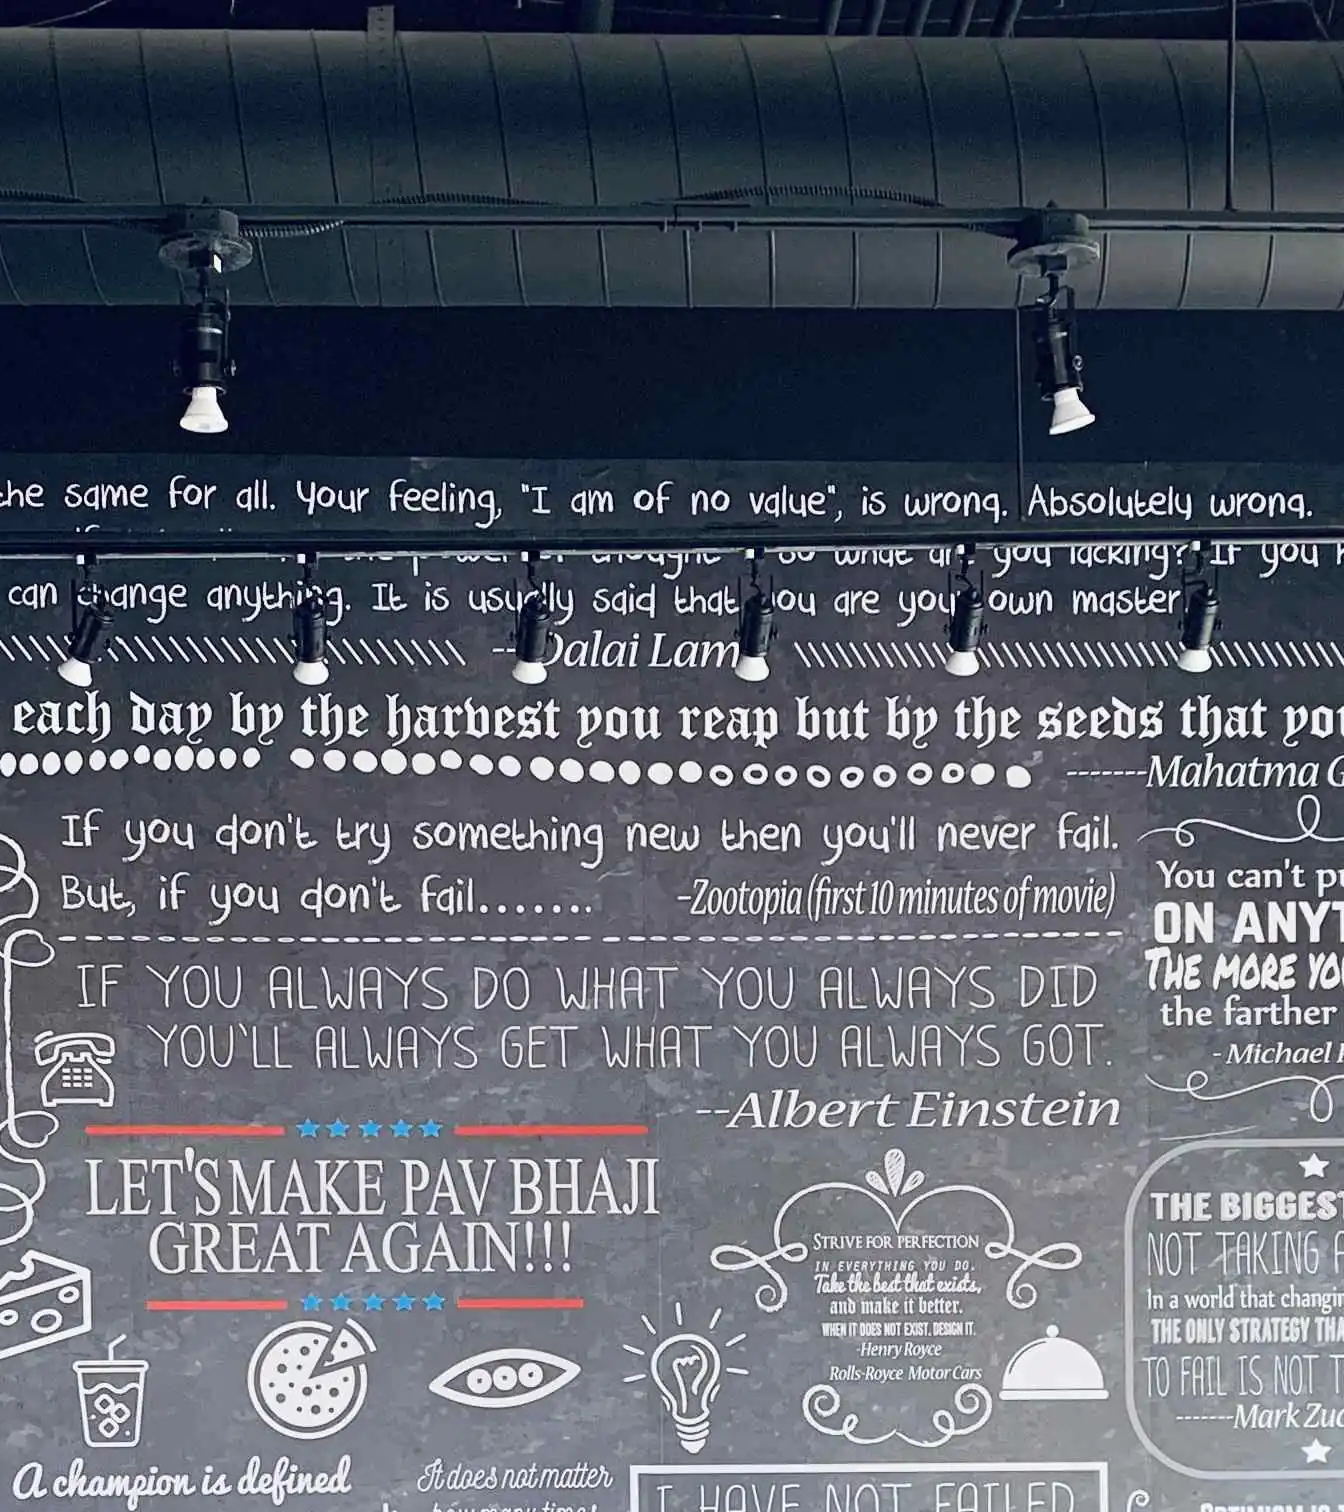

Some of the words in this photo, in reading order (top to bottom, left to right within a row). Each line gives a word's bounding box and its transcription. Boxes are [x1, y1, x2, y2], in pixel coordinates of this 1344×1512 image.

[64, 483, 149, 511] same
[168, 474, 217, 509] for
[236, 479, 276, 513] all.
[389, 476, 503, 527] feeling,
[570, 489, 614, 517] am
[633, 480, 674, 514] of
[691, 489, 730, 516] no
[861, 485, 887, 516] is
[1027, 483, 1192, 521] Absolutely
[13, 689, 111, 744] each
[129, 690, 213, 745] day
[229, 691, 284, 746] by
[300, 692, 369, 746] the
[385, 693, 561, 747] harvest
[576, 705, 662, 749] you
[678, 706, 778, 749] reap
[795, 695, 870, 741] but
[885, 695, 938, 749] by
[954, 695, 1022, 749] the
[1036, 696, 1164, 740] seeds
[1179, 694, 1268, 748] that
[1155, 860, 1215, 889] You
[1227, 858, 1306, 889] can't
[1153, 901, 1214, 944] ON
[76, 964, 123, 1008] IF
[145, 964, 242, 1009] YOU
[269, 965, 449, 1010] ALWAYS
[473, 966, 530, 1010] DO
[555, 966, 679, 1010] WHAT
[701, 966, 794, 1010] YOU
[820, 965, 995, 1009] ALWAYS
[1020, 964, 1097, 1008] DID
[400, 1158, 497, 1216] PAV
[508, 1157, 660, 1215] BHAJI
[1149, 1192, 1213, 1222] THE
[149, 1221, 330, 1274] GREAT
[340, 1220, 571, 1274] AGAIN!!!
[865, 1235, 894, 1249] FOR
[897, 1234, 979, 1249] PERFECTION
[815, 1260, 830, 1273] IN
[837, 1260, 915, 1273] EVERYTHING
[922, 1260, 947, 1273] YOU
[1146, 1287, 1164, 1310] In
[1168, 1294, 1179, 1310] a
[1183, 1283, 1239, 1309] world
[1239, 1283, 1276, 1309] that
